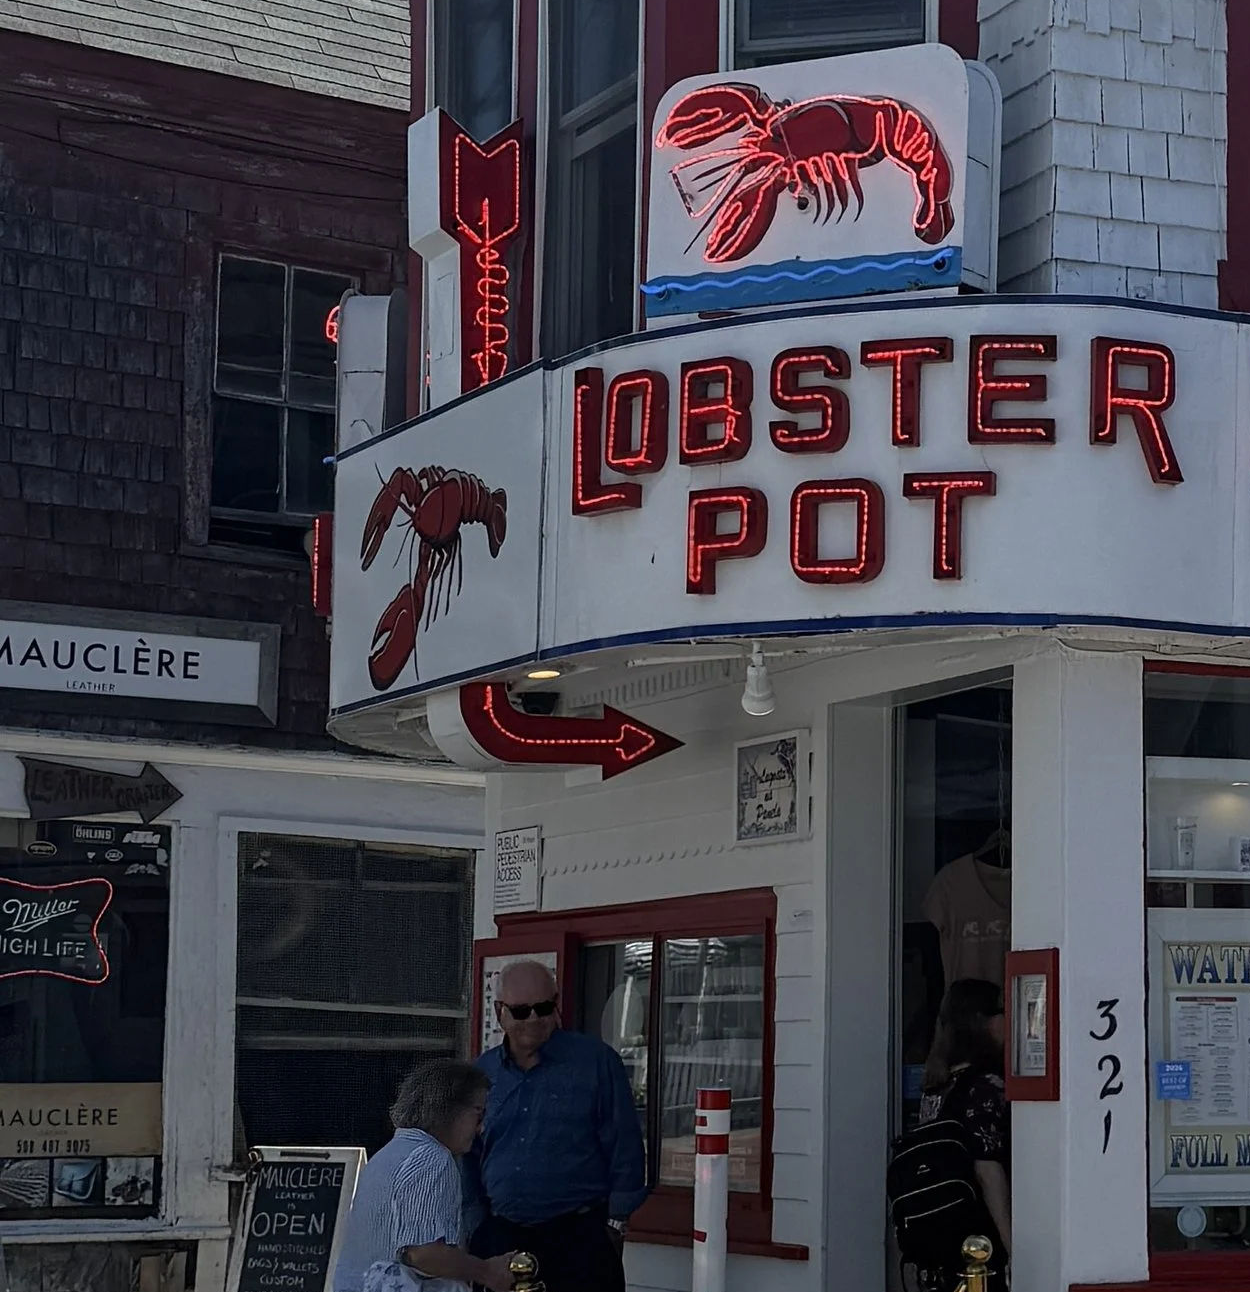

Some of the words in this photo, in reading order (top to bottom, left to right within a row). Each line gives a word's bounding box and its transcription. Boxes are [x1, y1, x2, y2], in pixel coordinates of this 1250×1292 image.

[571, 334, 1184, 516] LOBSTER
[686, 471, 996, 596] POT
[66, 680, 116, 692] LEATHER
[30, 768, 114, 804] LEATHER
[497, 834, 520, 851] PUBLIC
[497, 849, 537, 865] PEDESTRIAN
[496, 866, 522, 882] ACCESS
[3, 898, 80, 926] Miller
[0, 935, 38, 955] IGH
[42, 938, 87, 958] LIFE
[1088, 997, 1124, 1155] 321
[0, 1103, 119, 1126] AUCLÈRE
[1169, 1134, 1229, 1169] FULL
[258, 1163, 343, 1189] MAUCLÈRE
[274, 1191, 316, 1201] LEATHER
[251, 1211, 326, 1237] OPEN
[259, 1274, 304, 1289] CUSTOM
